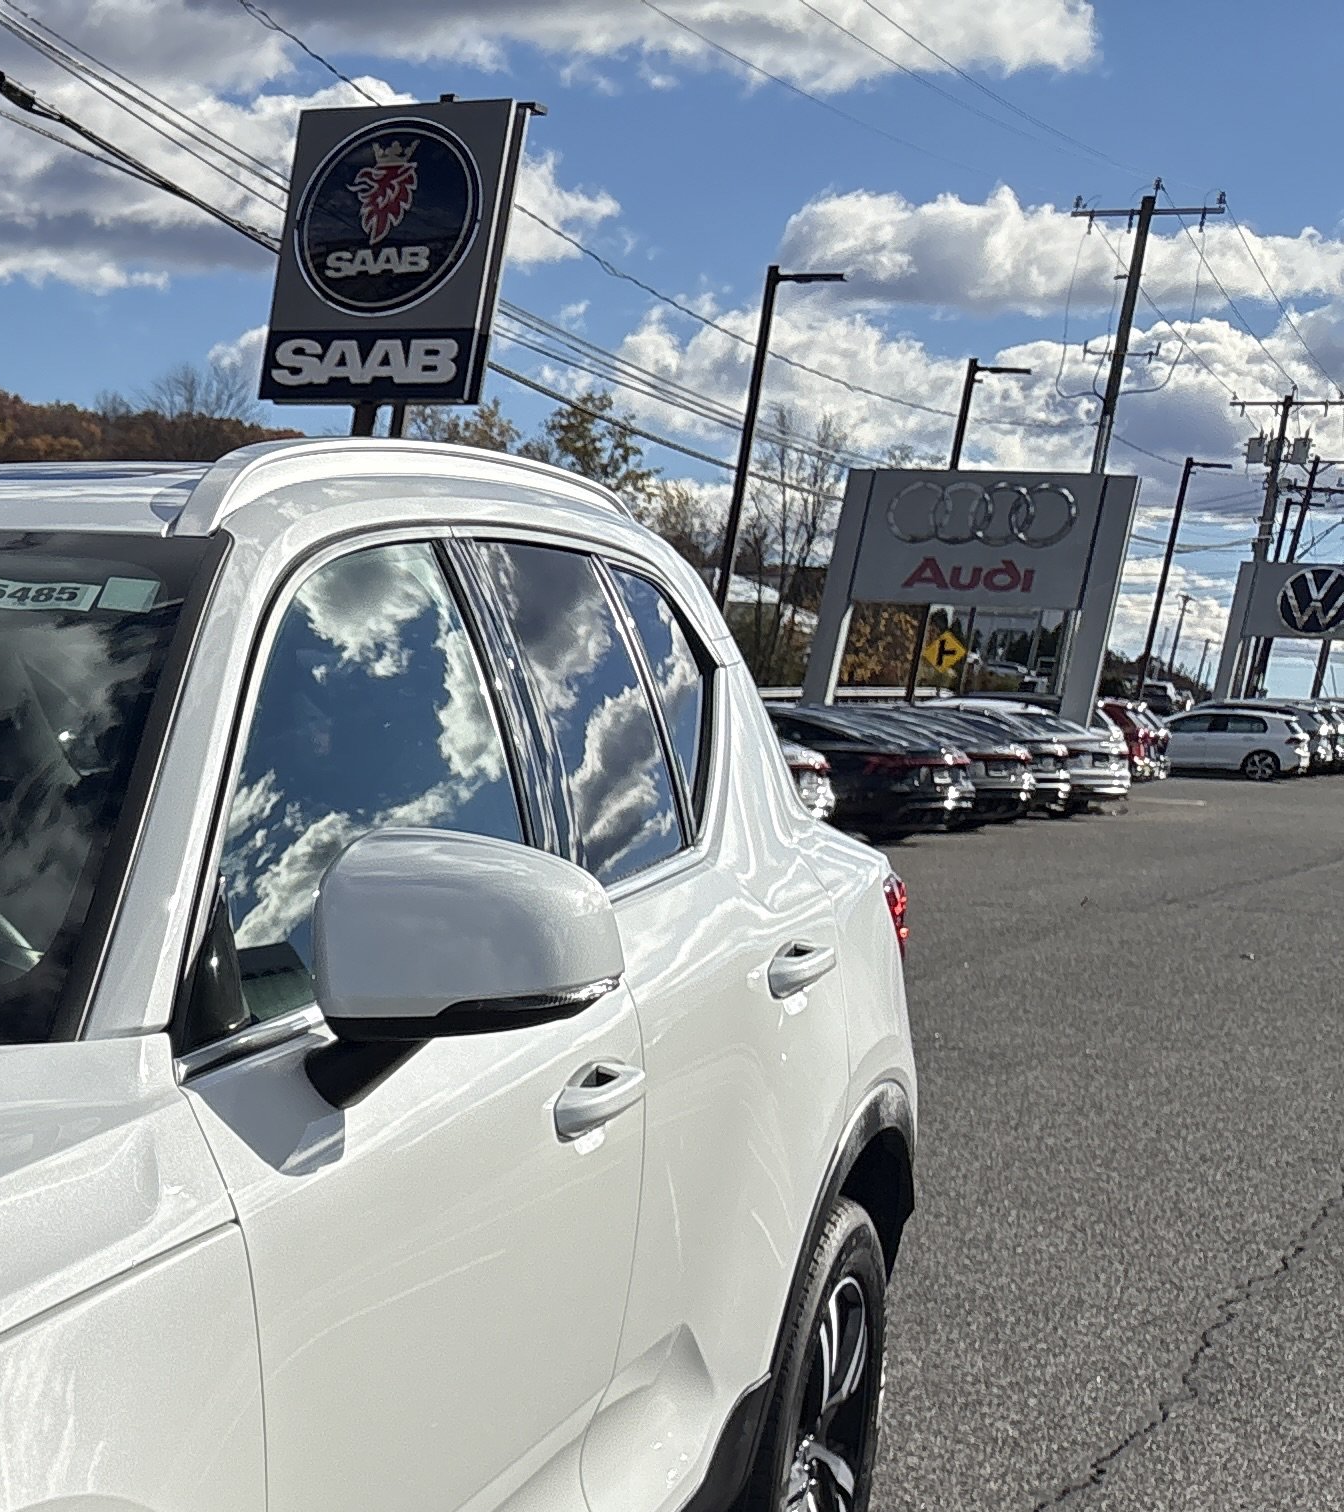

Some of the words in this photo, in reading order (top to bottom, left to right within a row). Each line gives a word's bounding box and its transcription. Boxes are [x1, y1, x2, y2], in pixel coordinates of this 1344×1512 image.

[324, 246, 430, 279] SAAB
[271, 337, 459, 386] SAAB
[901, 556, 1036, 593] Audi
